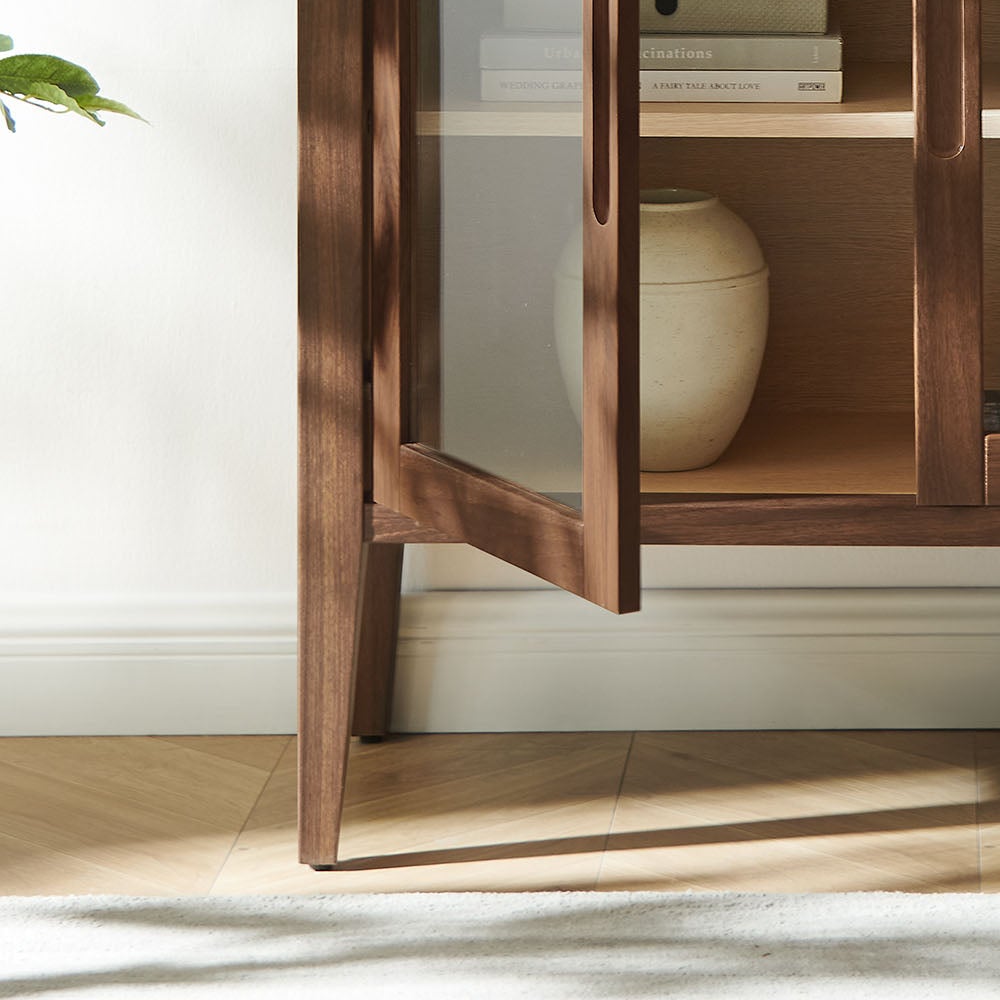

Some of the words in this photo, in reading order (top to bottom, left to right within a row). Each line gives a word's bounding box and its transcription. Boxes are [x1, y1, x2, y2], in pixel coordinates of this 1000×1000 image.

[543, 47, 583, 60] Urba
[639, 47, 714, 60] cinations
[685, 82, 706, 90] TALE
[709, 82, 737, 90] ABOUT
[738, 82, 761, 90] LOVE
